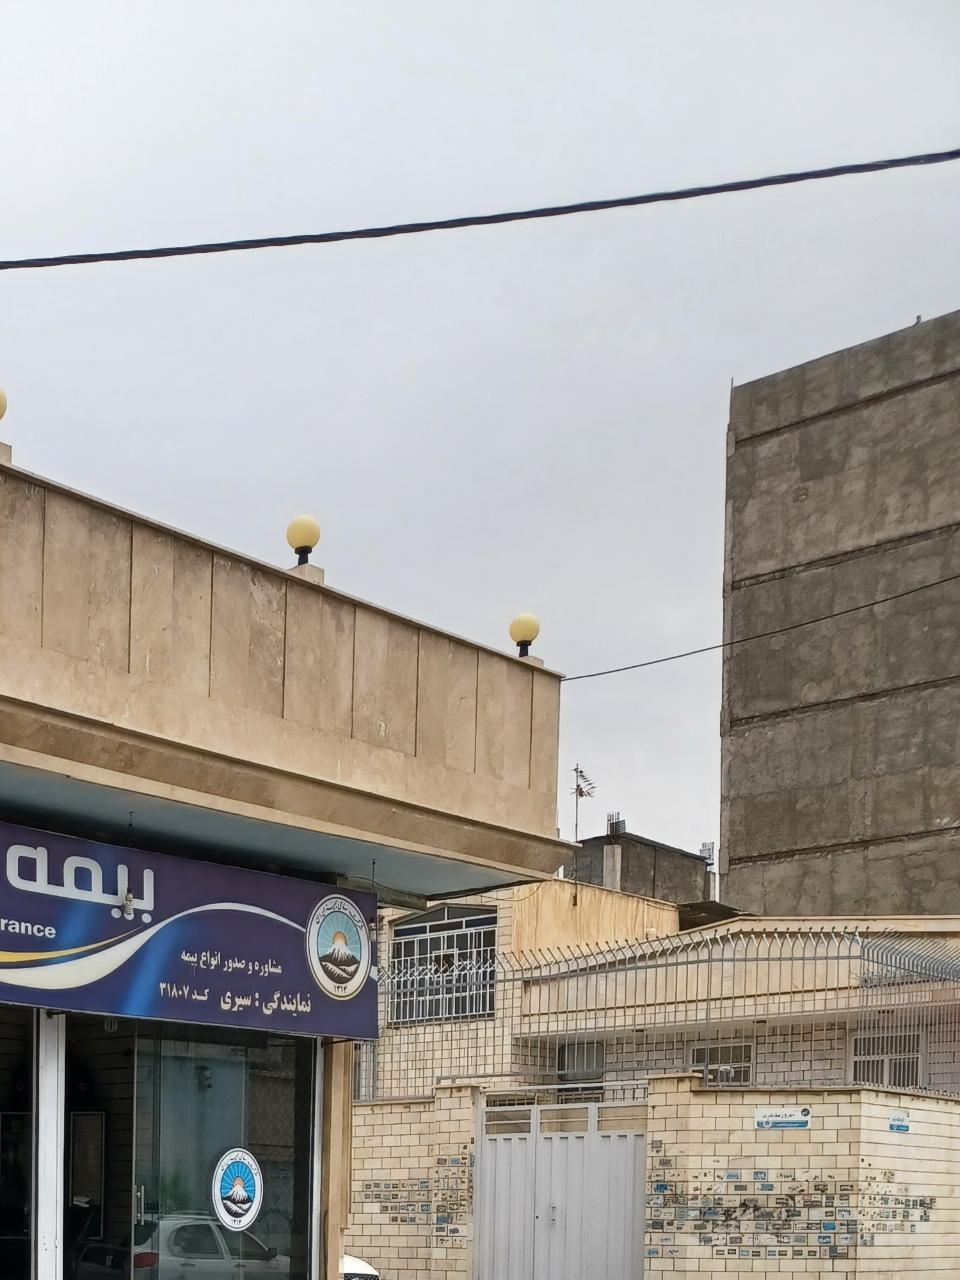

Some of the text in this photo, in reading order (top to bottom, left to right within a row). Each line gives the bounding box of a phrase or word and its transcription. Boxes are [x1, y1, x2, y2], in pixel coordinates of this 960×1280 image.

[6, 844, 154, 923] بیمه
[180, 950, 283, 976] مشاوره و صدور انواع بیمه
[159, 981, 190, 999] ۳۱۸۰۷
[220, 991, 252, 1011] سیری
[262, 990, 311, 1016] نمایندگی
